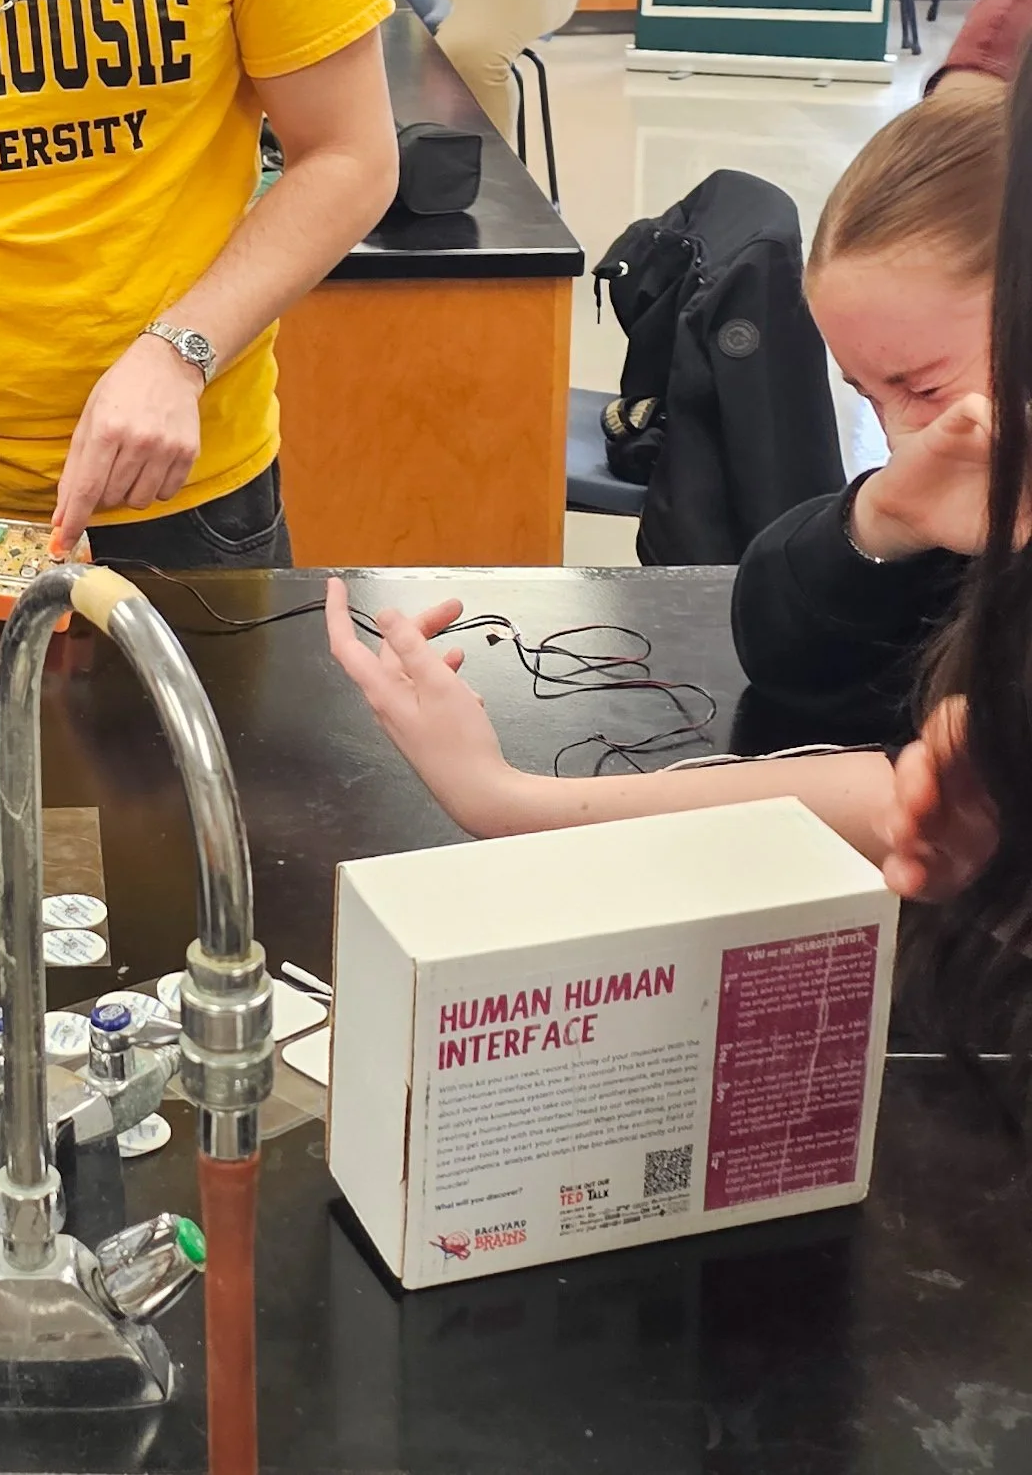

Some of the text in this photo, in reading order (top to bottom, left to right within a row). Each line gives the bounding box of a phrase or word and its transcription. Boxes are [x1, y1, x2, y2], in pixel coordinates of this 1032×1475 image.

[746, 948, 765, 962] YOU
[440, 964, 676, 1034] HUMAN HUMAN
[438, 1013, 598, 1070] INTERFACE
[560, 1191, 583, 1206] TED
[475, 1220, 527, 1236] BACKYARD
[474, 1229, 527, 1251] BRAINS
